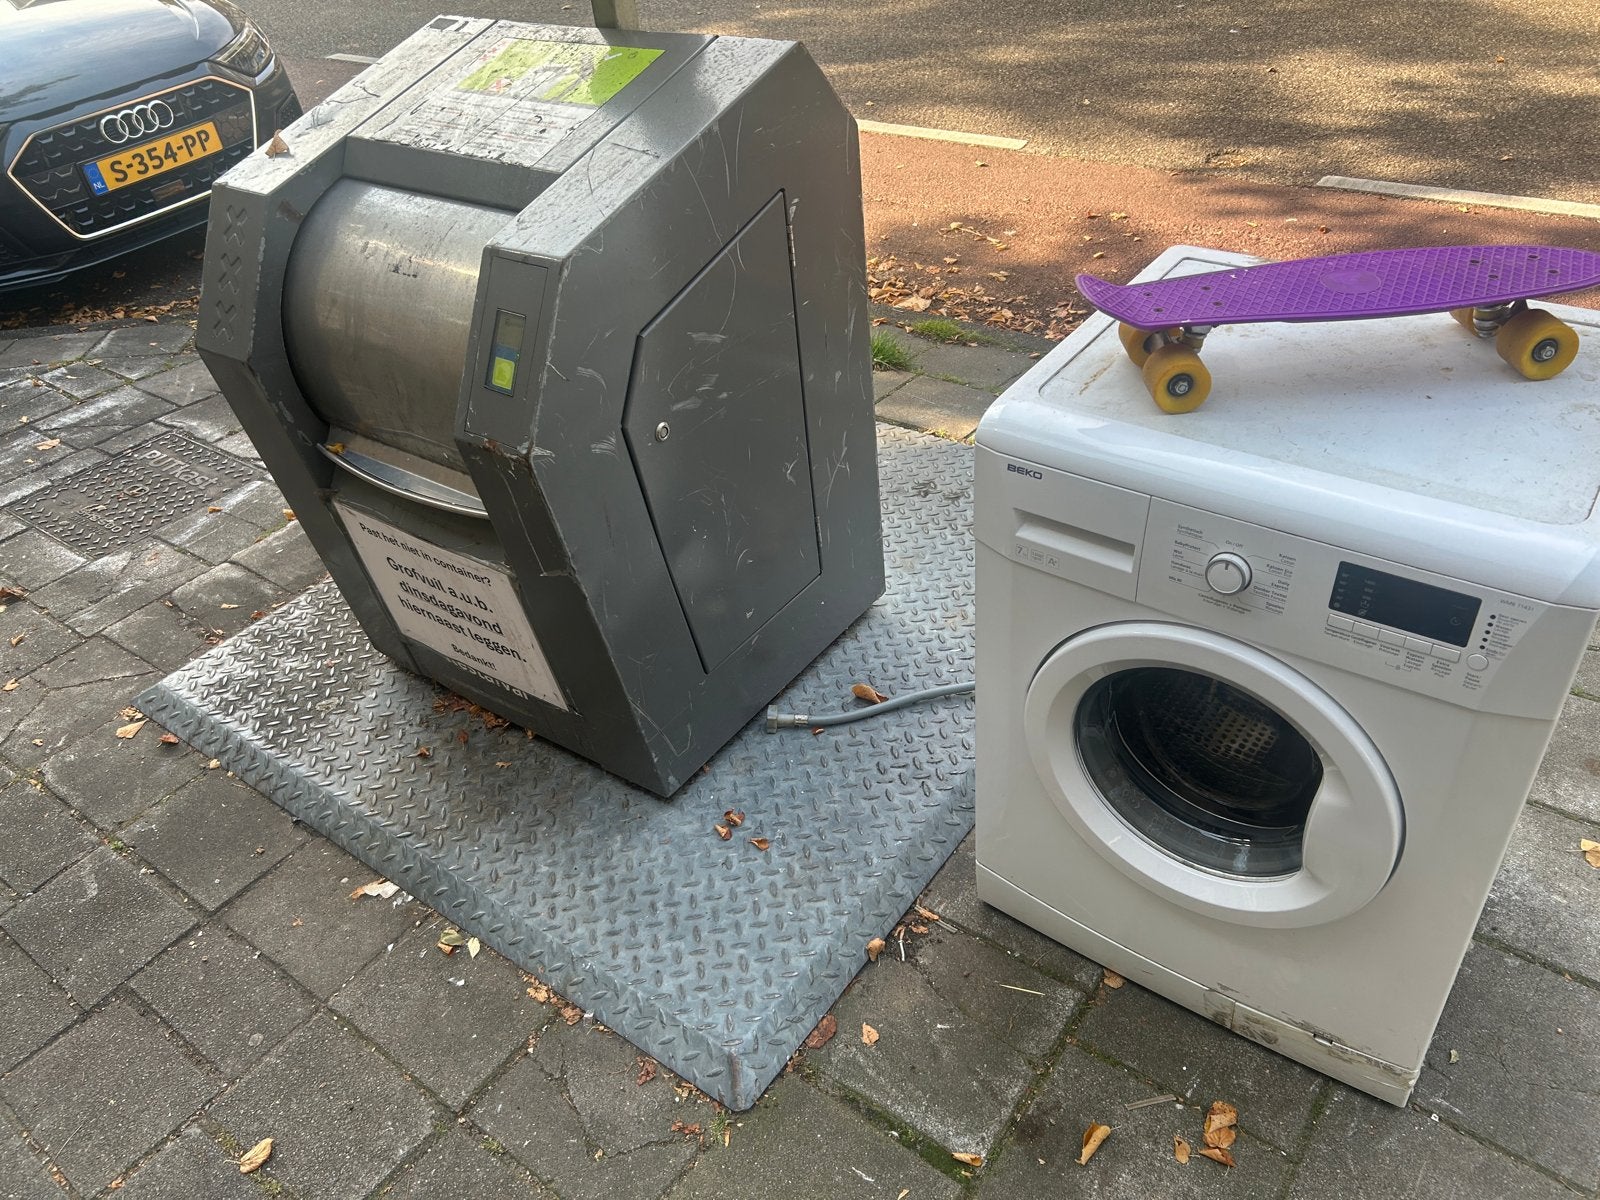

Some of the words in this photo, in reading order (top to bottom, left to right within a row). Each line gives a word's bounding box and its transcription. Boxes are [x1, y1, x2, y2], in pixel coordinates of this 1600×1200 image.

[109, 129, 210, 183] S-354-PP
[93, 181, 106, 190] NL
[1007, 463, 1043, 480] BEKO
[359, 522, 382, 539] Past
[382, 533, 401, 548] het
[400, 542, 421, 558] niet
[420, 549, 432, 563] in
[433, 557, 492, 587] container?
[386, 556, 447, 594] Grofvuil
[448, 587, 494, 614] a.u.b.
[399, 580, 504, 636] dinsdagavond
[397, 594, 468, 637] hiernaast
[467, 627, 527, 663] leggen.
[451, 643, 498, 671] Bedankt!
